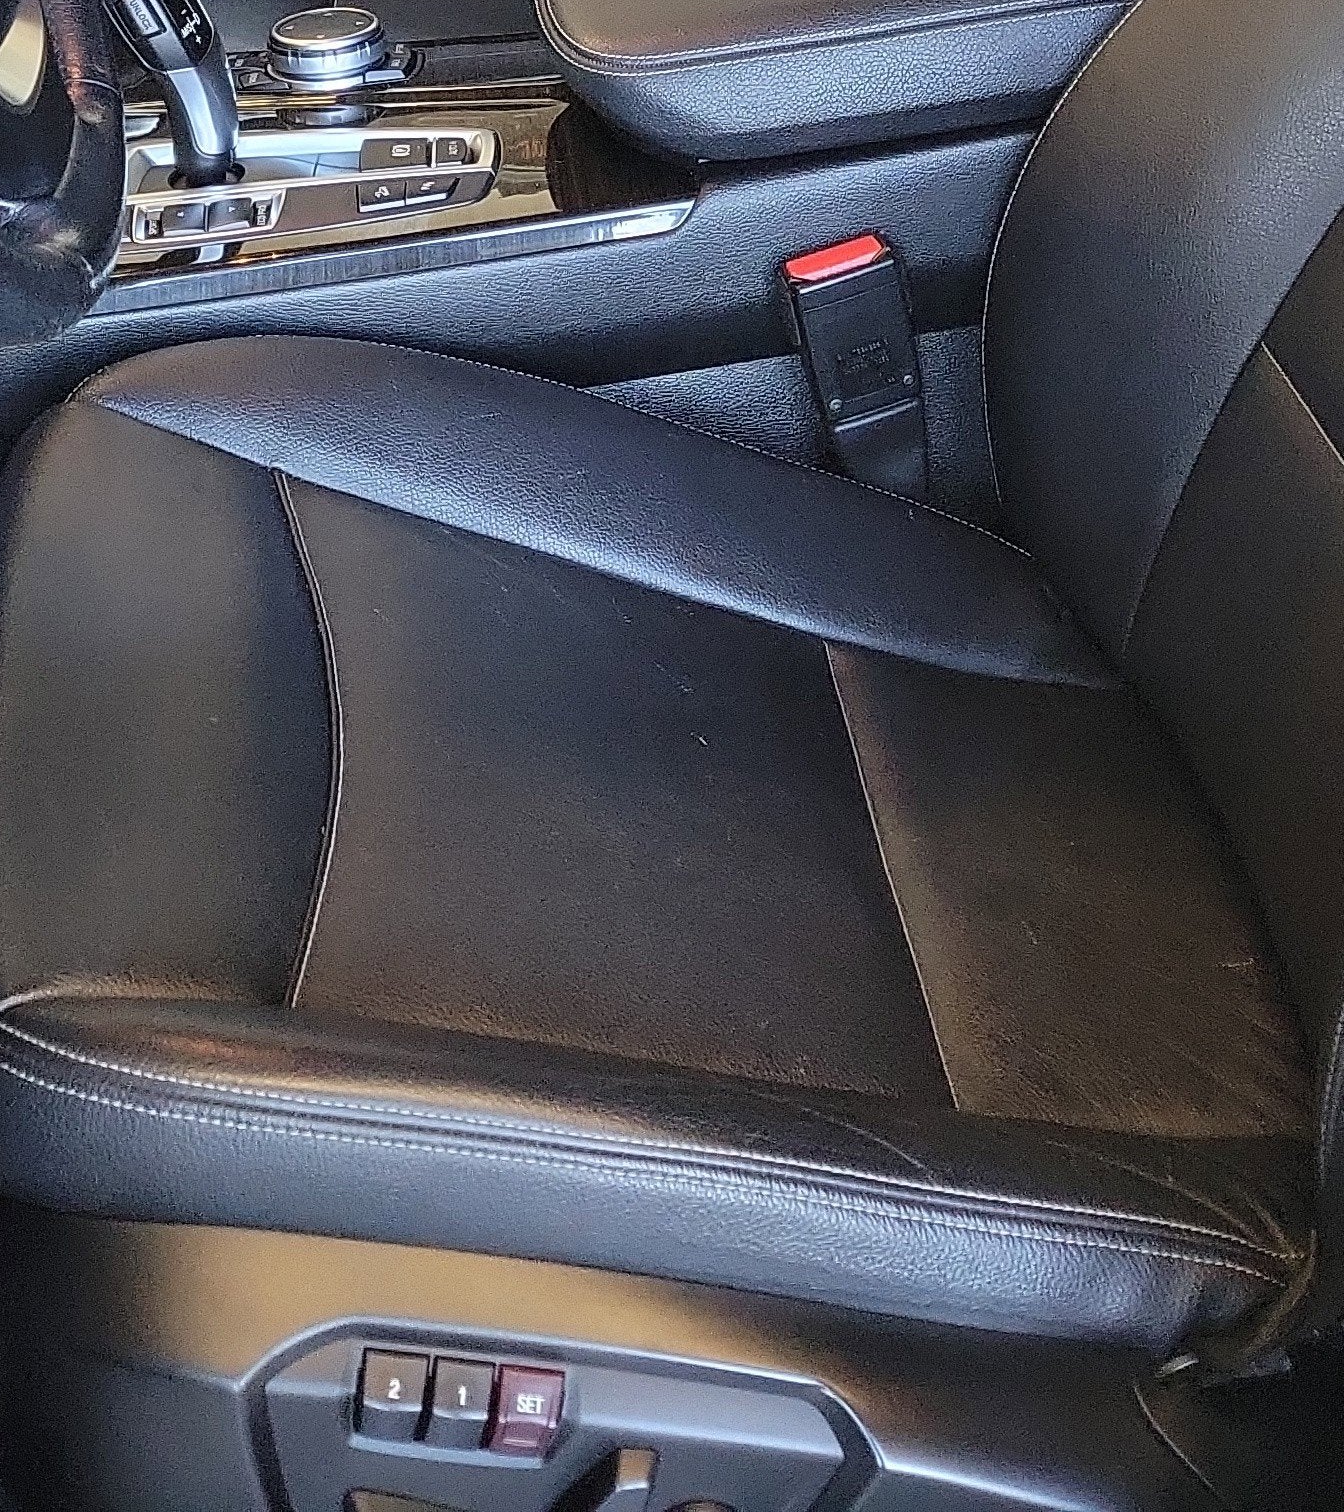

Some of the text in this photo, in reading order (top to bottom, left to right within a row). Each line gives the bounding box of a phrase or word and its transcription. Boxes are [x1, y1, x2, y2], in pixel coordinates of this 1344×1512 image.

[388, 1377, 401, 1400] 2
[457, 1385, 467, 1406] 1
[516, 1394, 546, 1415] SET
